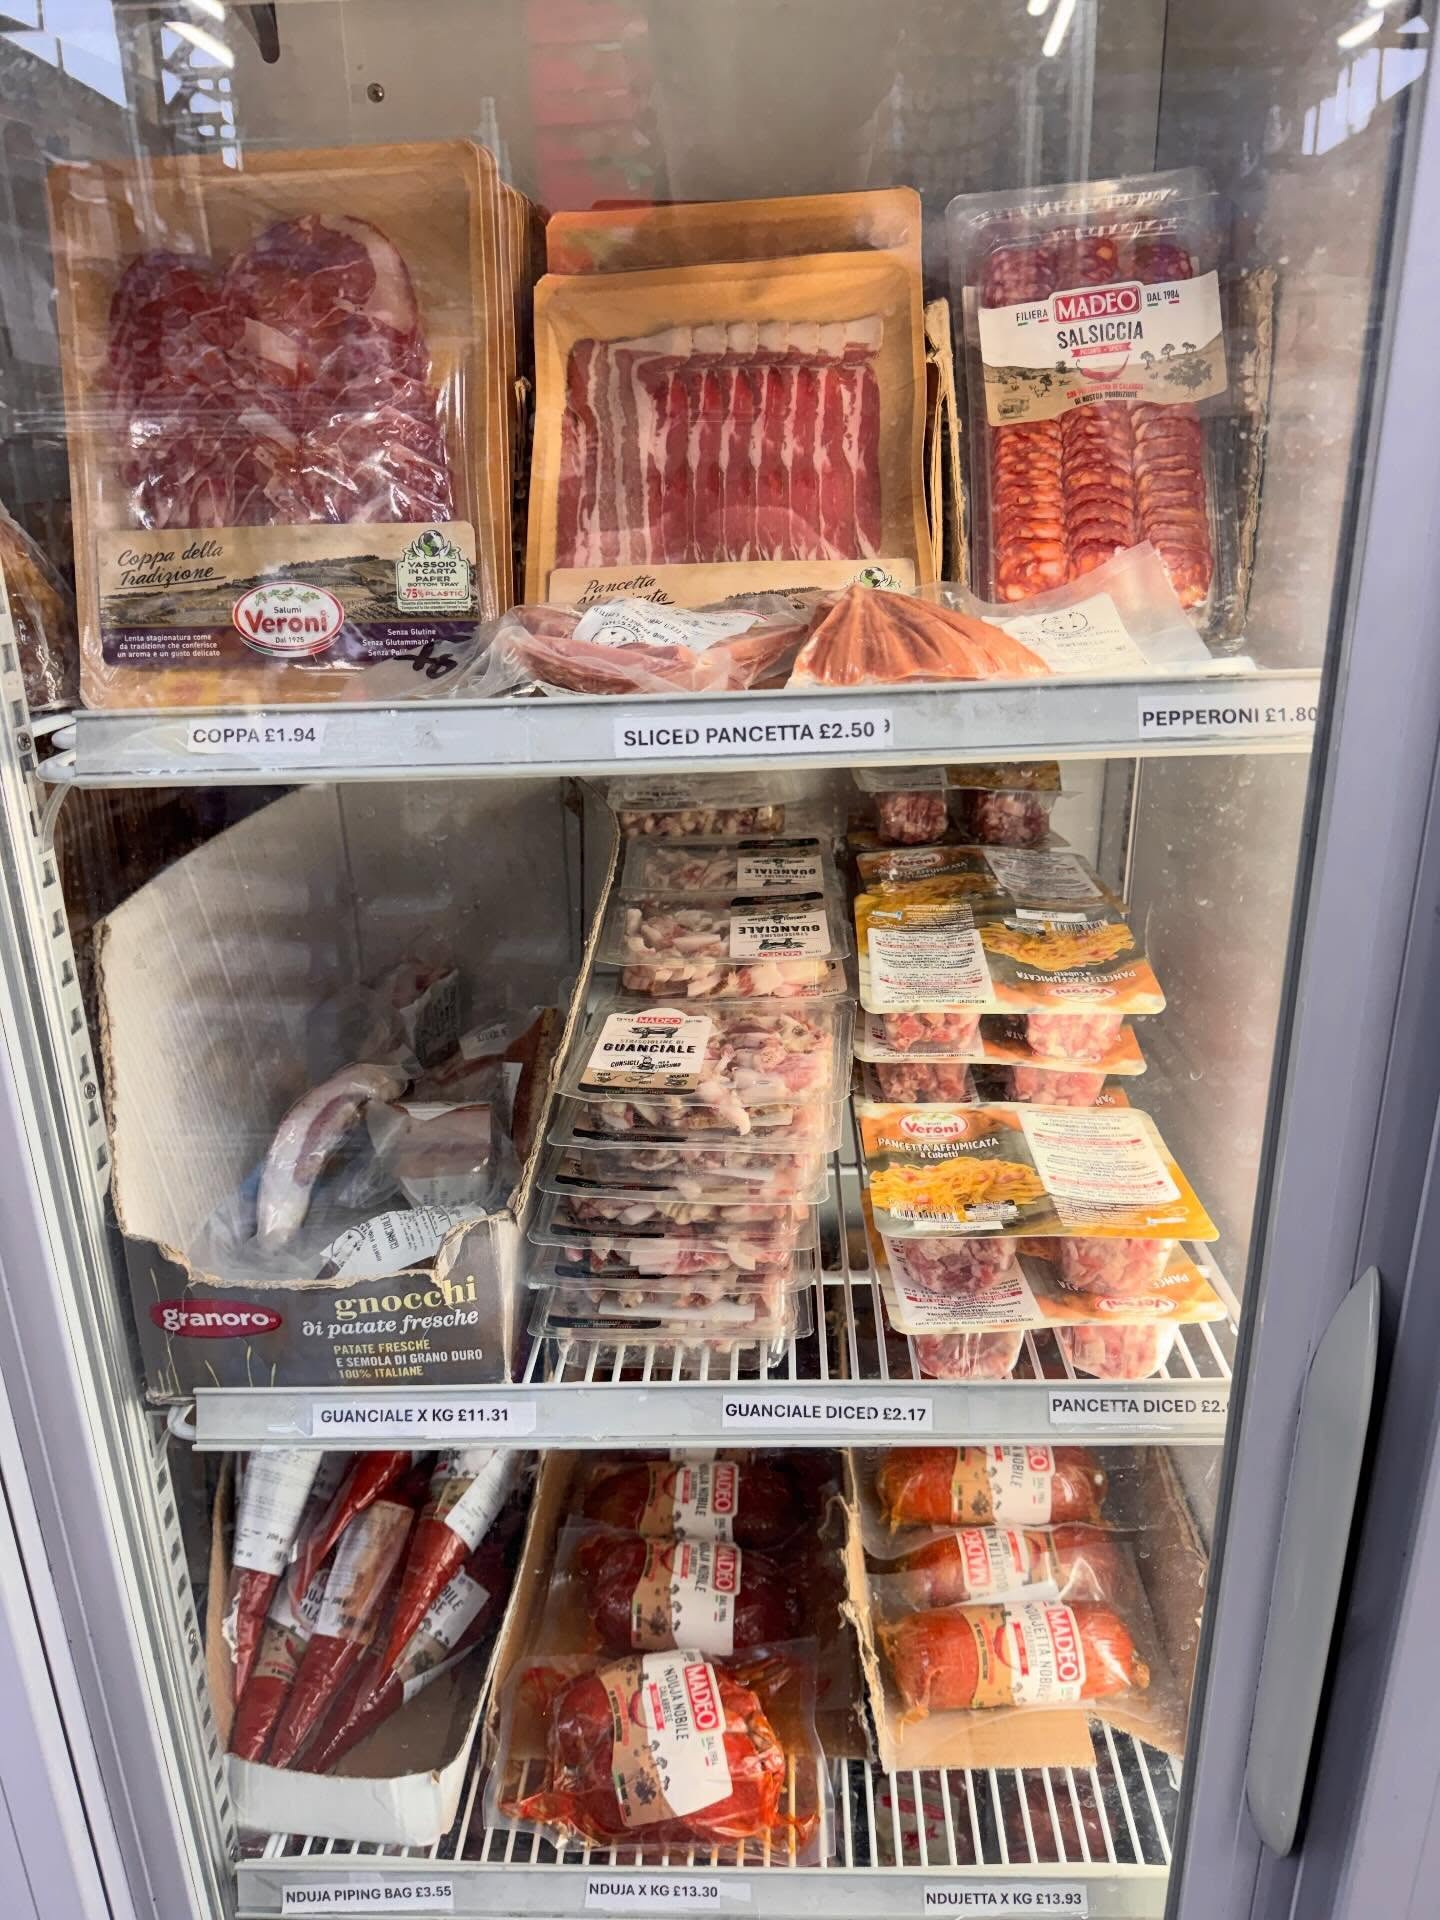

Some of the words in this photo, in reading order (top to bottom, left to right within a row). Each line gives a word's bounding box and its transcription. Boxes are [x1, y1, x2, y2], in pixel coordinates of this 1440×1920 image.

[1147, 291, 1162, 302] DAL
[1163, 289, 1180, 300] 1984
[1057, 289, 1137, 321] MADEO
[1016, 309, 1049, 322] FILIERA
[1057, 321, 1144, 349] SALSICCIA
[117, 549, 175, 570] Coppa
[181, 540, 223, 561] della
[120, 566, 214, 588] Tradizione
[584, 574, 657, 595] Pancetta
[273, 606, 302, 614] Salumi
[244, 609, 328, 633] Veroni
[146, 634, 191, 643] stagionatura
[275, 636, 287, 644] Dal
[362, 639, 383, 647] Senza
[385, 638, 429, 646] Glutammato
[368, 649, 389, 657] Senza
[1142, 708, 1259, 727] PEPPERONI
[1265, 707, 1318, 723] £1.80
[192, 728, 260, 743] COPPA
[264, 727, 316, 743] £1.94
[624, 728, 699, 747] SLICED
[706, 724, 814, 744] PANCETTA
[819, 721, 875, 740] £2.50
[738, 924, 821, 935] GUANCIALE
[1015, 970, 1079, 983] AFFUMICATA
[1082, 969, 1136, 983] PANCETTA
[603, 1043, 696, 1053] GUANCIALE
[905, 1121, 960, 1134] Veroni
[877, 1137, 931, 1152] PANCETTA
[931, 1137, 1000, 1152] AFFUMICATA
[927, 1151, 960, 1159] Cubetti
[334, 1275, 478, 1322] gnocchi
[162, 1308, 268, 1331] granoro
[302, 1320, 325, 1337] di
[328, 1320, 396, 1339] patate
[400, 1308, 479, 1335] fresche
[333, 1342, 376, 1355] PATATE
[379, 1339, 431, 1352] FRESCHE
[336, 1356, 345, 1367] E
[346, 1354, 392, 1367] SEMOLA
[395, 1353, 407, 1365] DI
[410, 1351, 447, 1364] GRANO
[451, 1349, 483, 1362] DURO
[338, 1367, 372, 1379] 100%
[375, 1366, 424, 1378] ITALIANE
[725, 1403, 822, 1419] GUANCIALE
[826, 1405, 879, 1420] DICED
[882, 1407, 926, 1421] £2.17
[1052, 1398, 1140, 1413] PANCETTA
[1143, 1400, 1197, 1413] DICED
[321, 1409, 413, 1423] GUANCIALE
[417, 1409, 427, 1421] X
[432, 1408, 454, 1421] KG
[458, 1408, 509, 1421] £11.31
[1048, 1610, 1078, 1681] MADEO
[687, 1665, 716, 1730] MADEO
[673, 1703, 689, 1741] NOBILE
[286, 1889, 331, 1903] NDUJA
[334, 1888, 381, 1901] PIPING
[385, 1887, 412, 1899] BAG
[415, 1885, 452, 1898] £3.55
[589, 1883, 635, 1896] NDUJA
[638, 1884, 647, 1896] X
[651, 1885, 670, 1896] KG
[673, 1885, 718, 1898] £13.30
[926, 1892, 997, 1905] NDUJETTA
[1000, 1892, 1009, 1904] X
[1013, 1892, 1032, 1904] KG
[1035, 1893, 1082, 1905] £13.93
